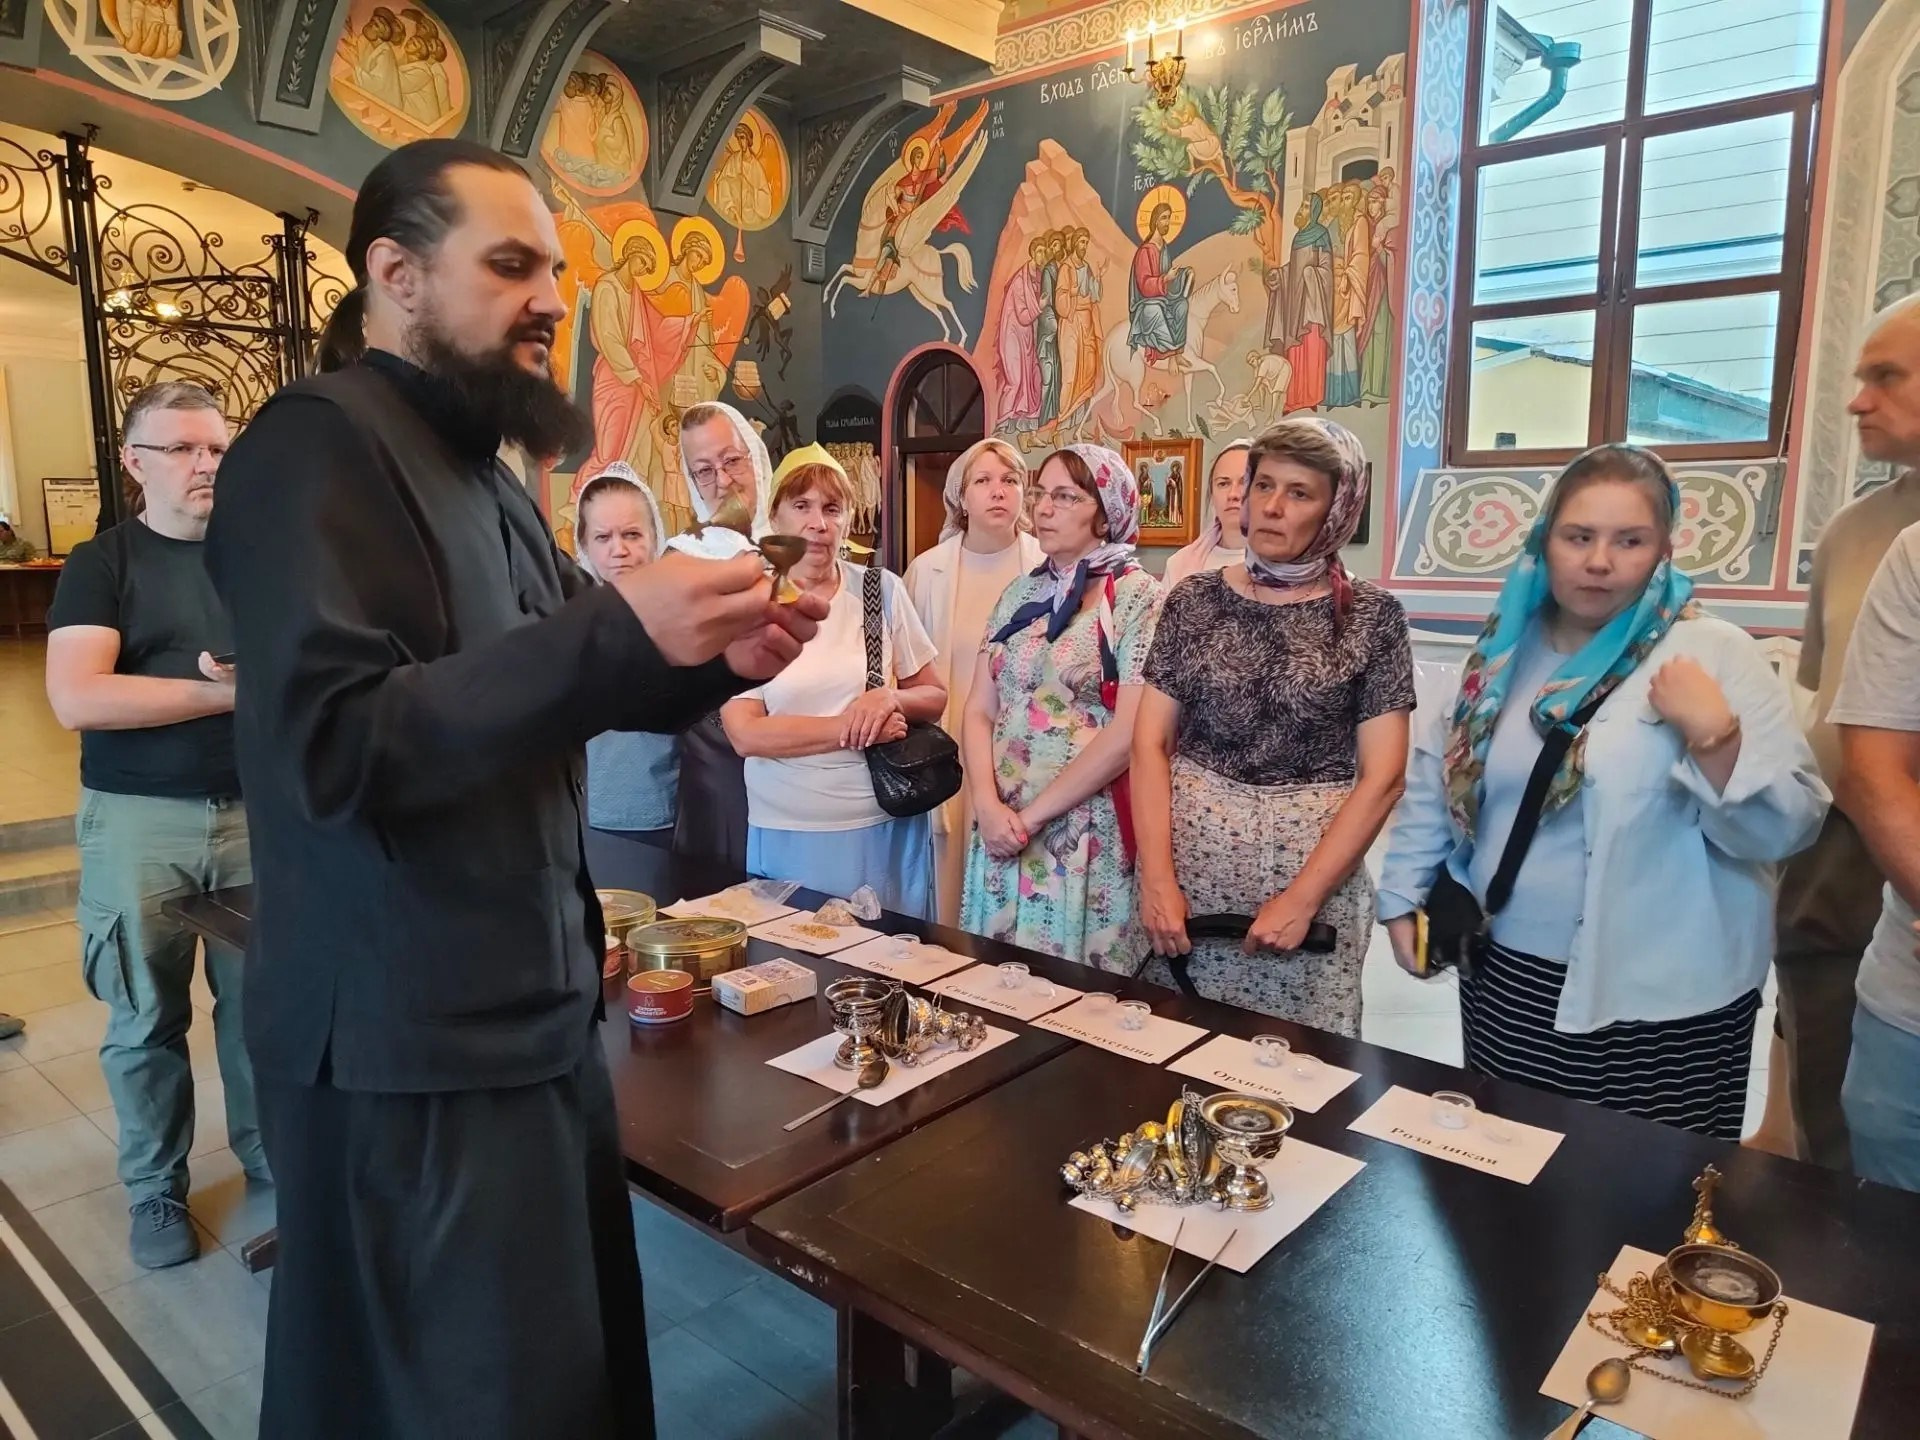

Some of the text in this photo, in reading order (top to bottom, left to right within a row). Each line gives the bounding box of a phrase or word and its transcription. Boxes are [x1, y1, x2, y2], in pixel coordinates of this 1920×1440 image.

[1213, 1070, 1282, 1095] Орхидея
[1390, 1127, 1497, 1165] Роза дикая
